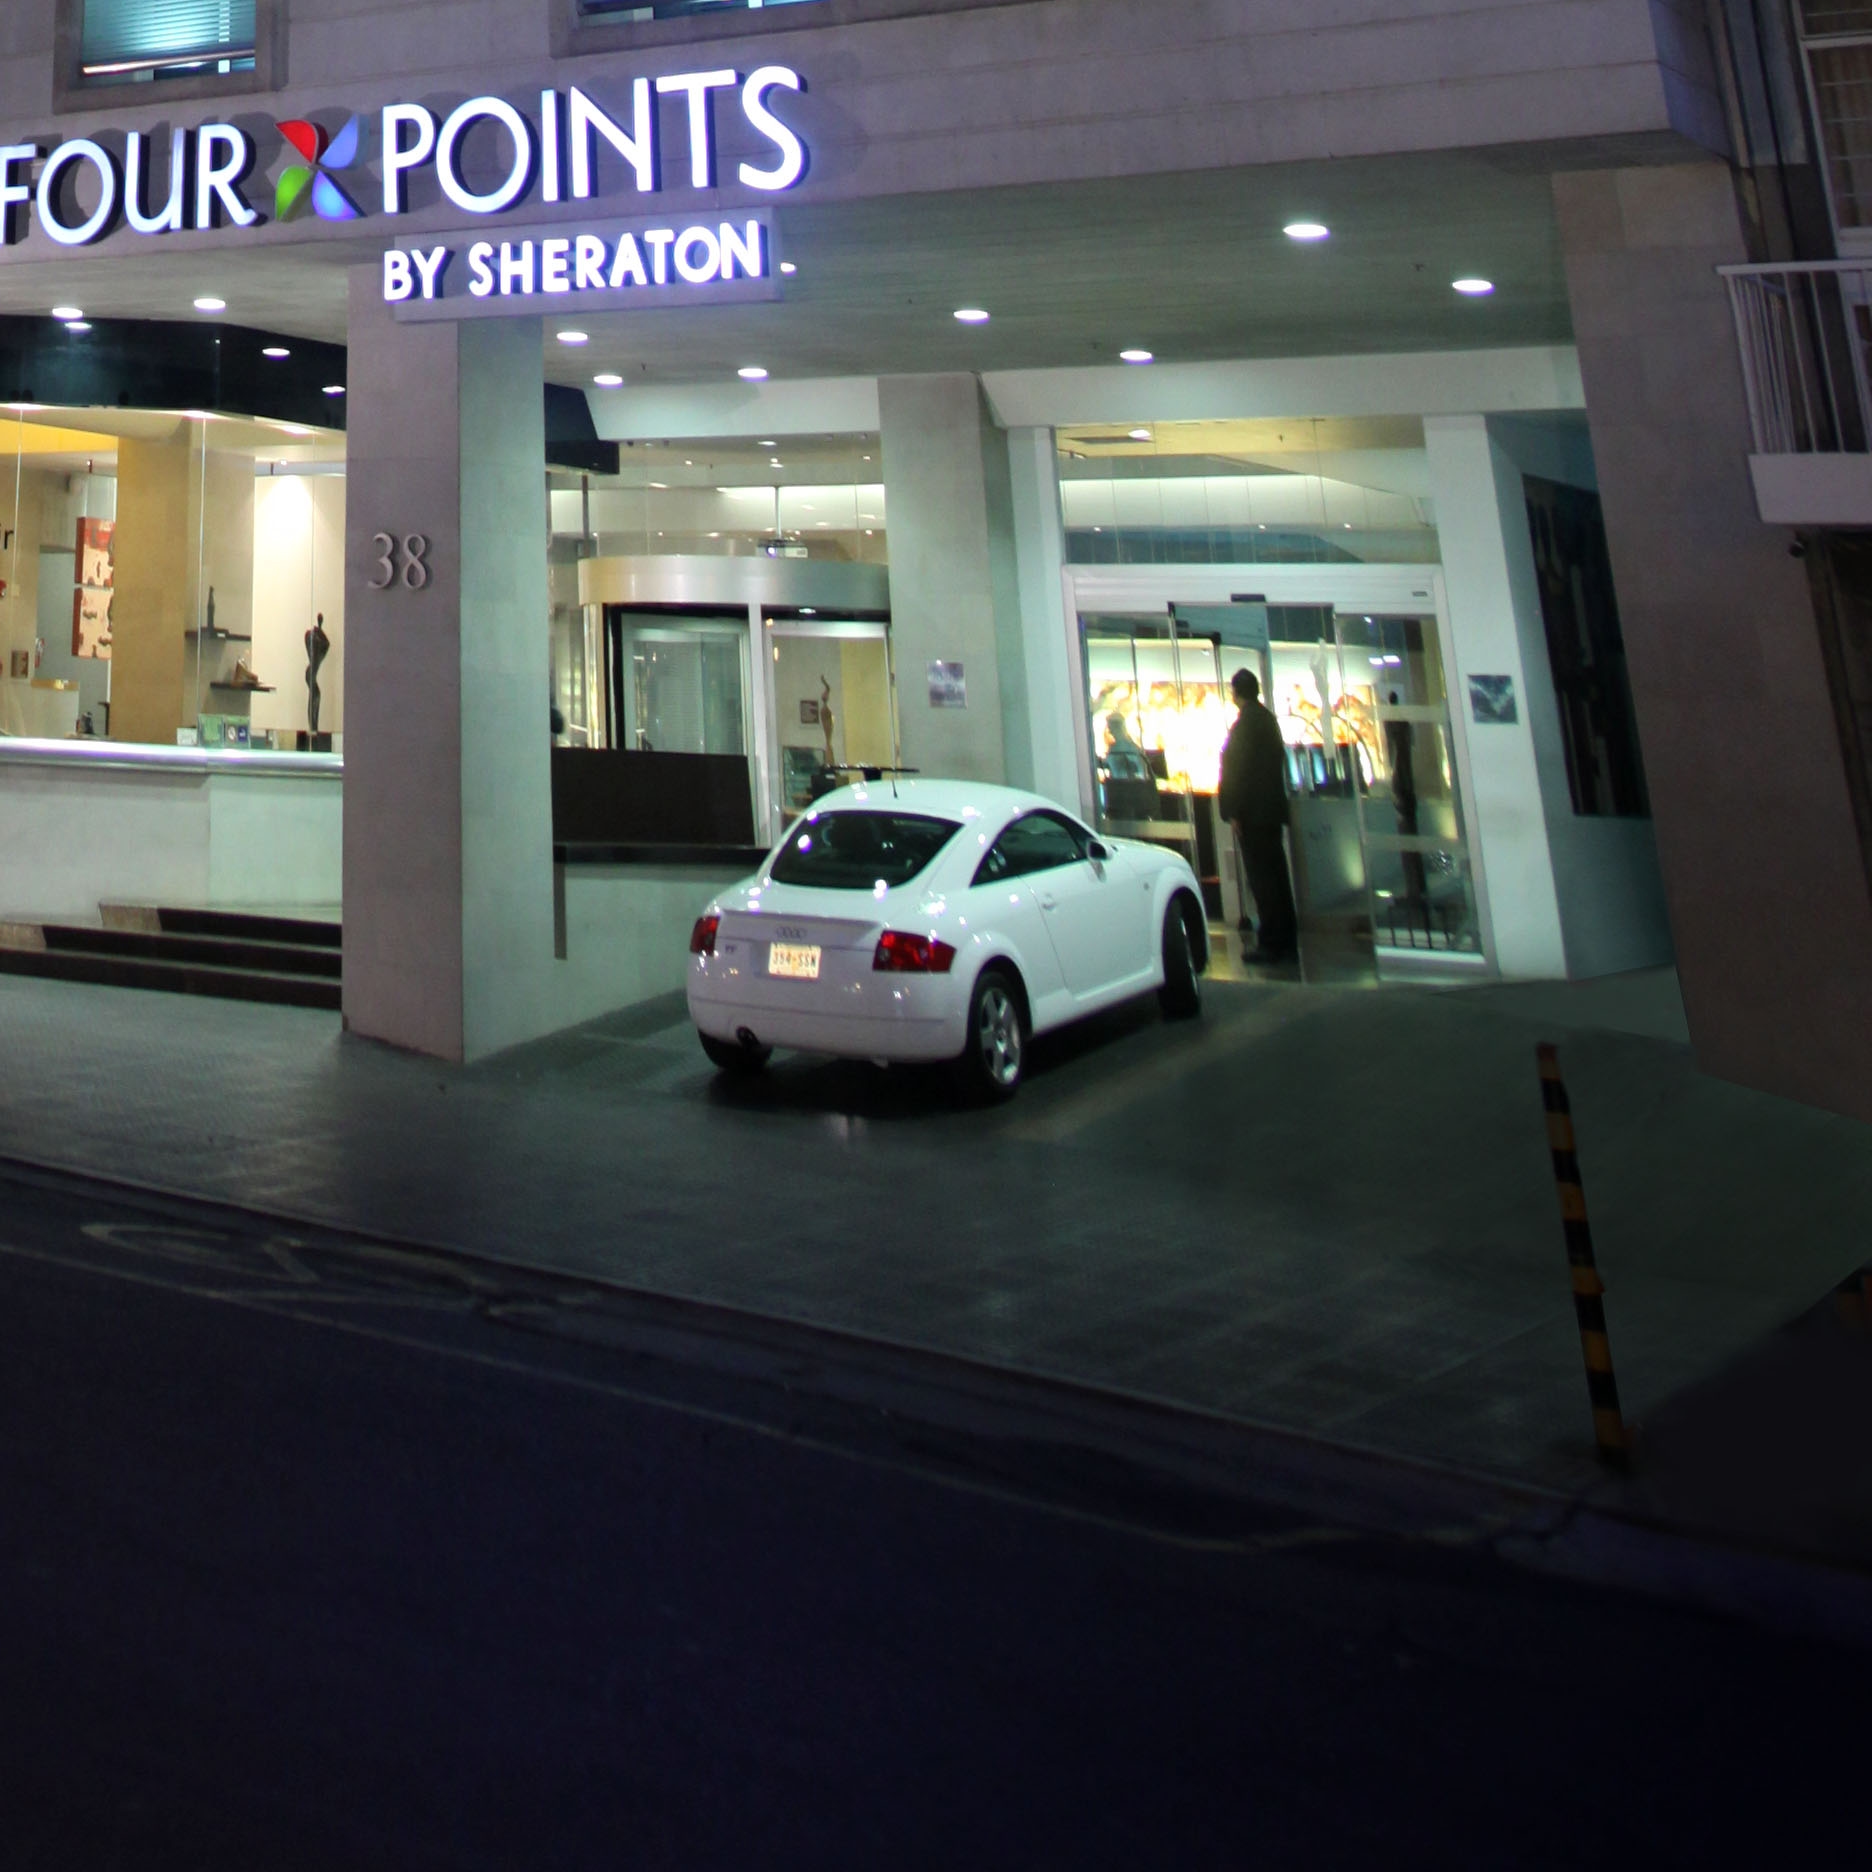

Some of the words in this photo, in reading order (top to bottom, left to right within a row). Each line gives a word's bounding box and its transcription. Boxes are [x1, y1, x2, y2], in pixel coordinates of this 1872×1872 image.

[381, 64, 804, 215] POINTS
[382, 245, 447, 302] BY
[467, 218, 762, 298] SHERATON
[367, 532, 427, 589] 38
